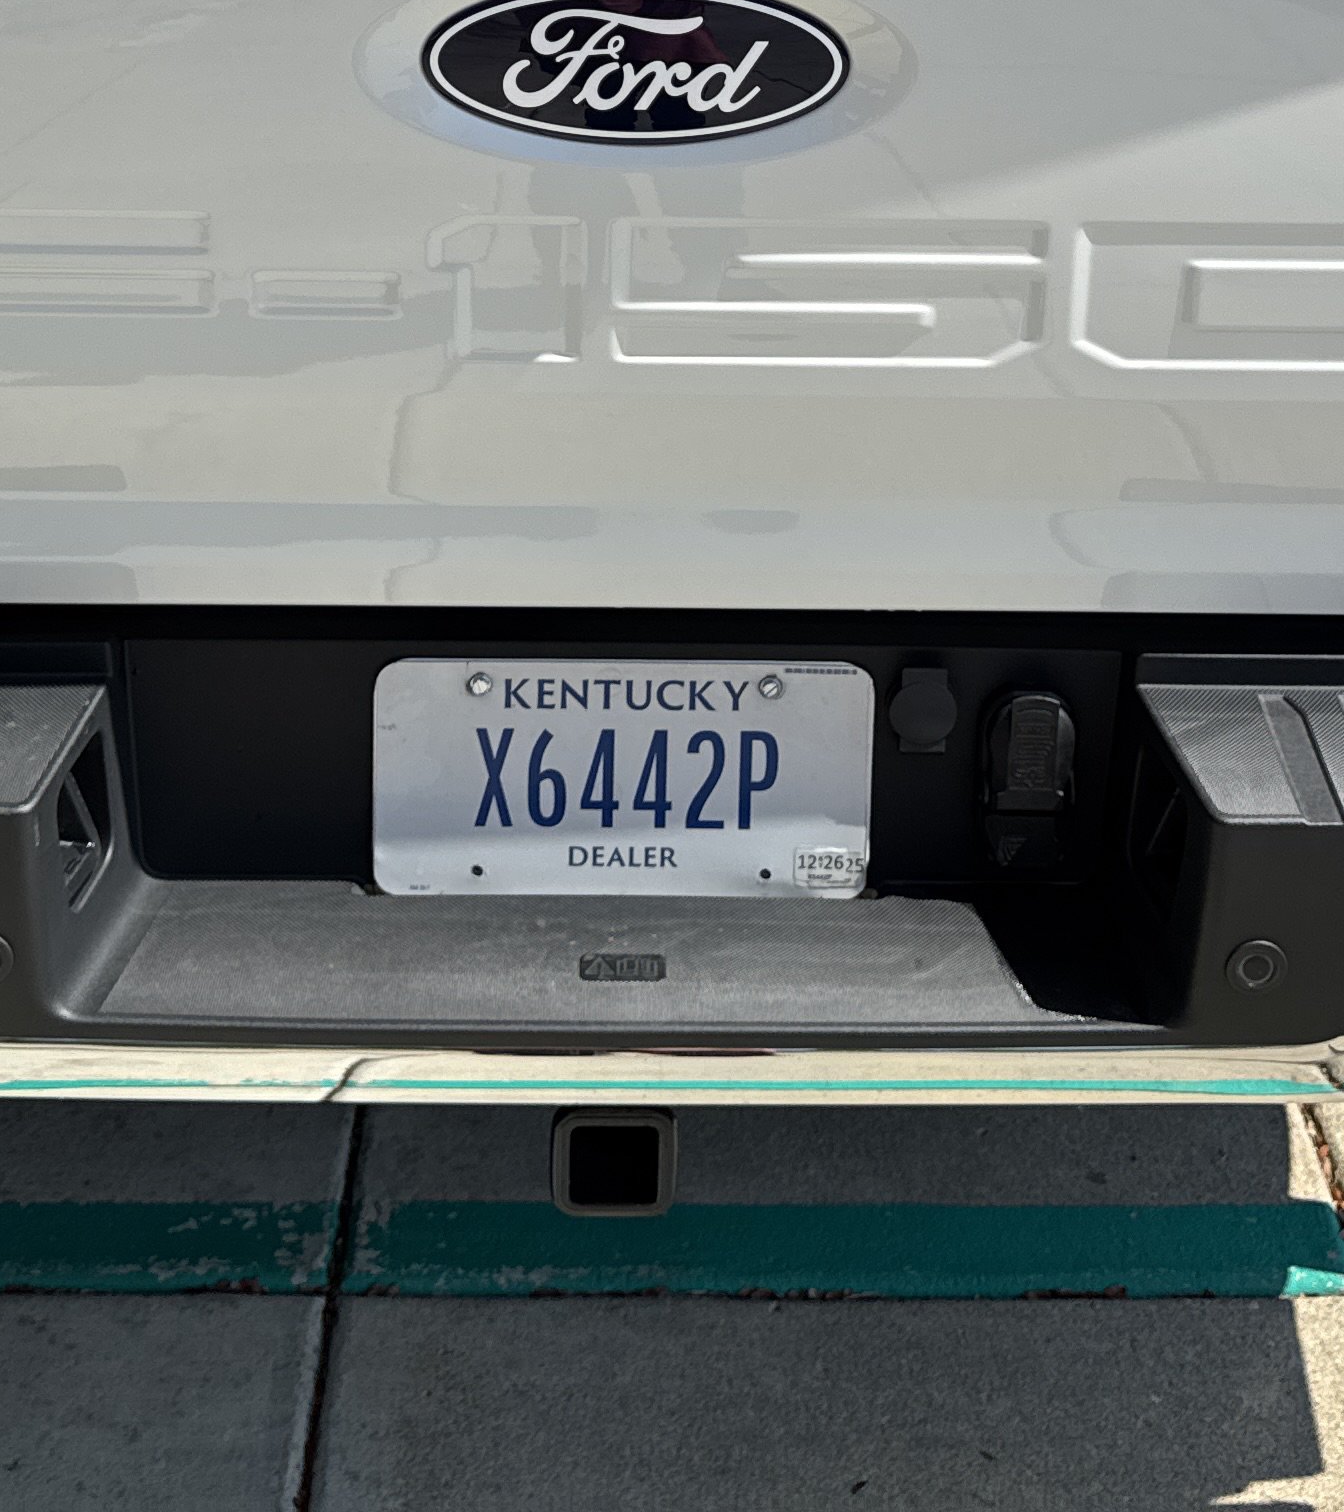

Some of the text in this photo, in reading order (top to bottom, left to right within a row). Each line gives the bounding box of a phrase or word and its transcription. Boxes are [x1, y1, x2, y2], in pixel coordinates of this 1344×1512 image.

[502, 8, 769, 113] Ford
[504, 677, 750, 712] KENTUCKY
[474, 727, 780, 830] X6442P
[567, 846, 678, 868] DEALER
